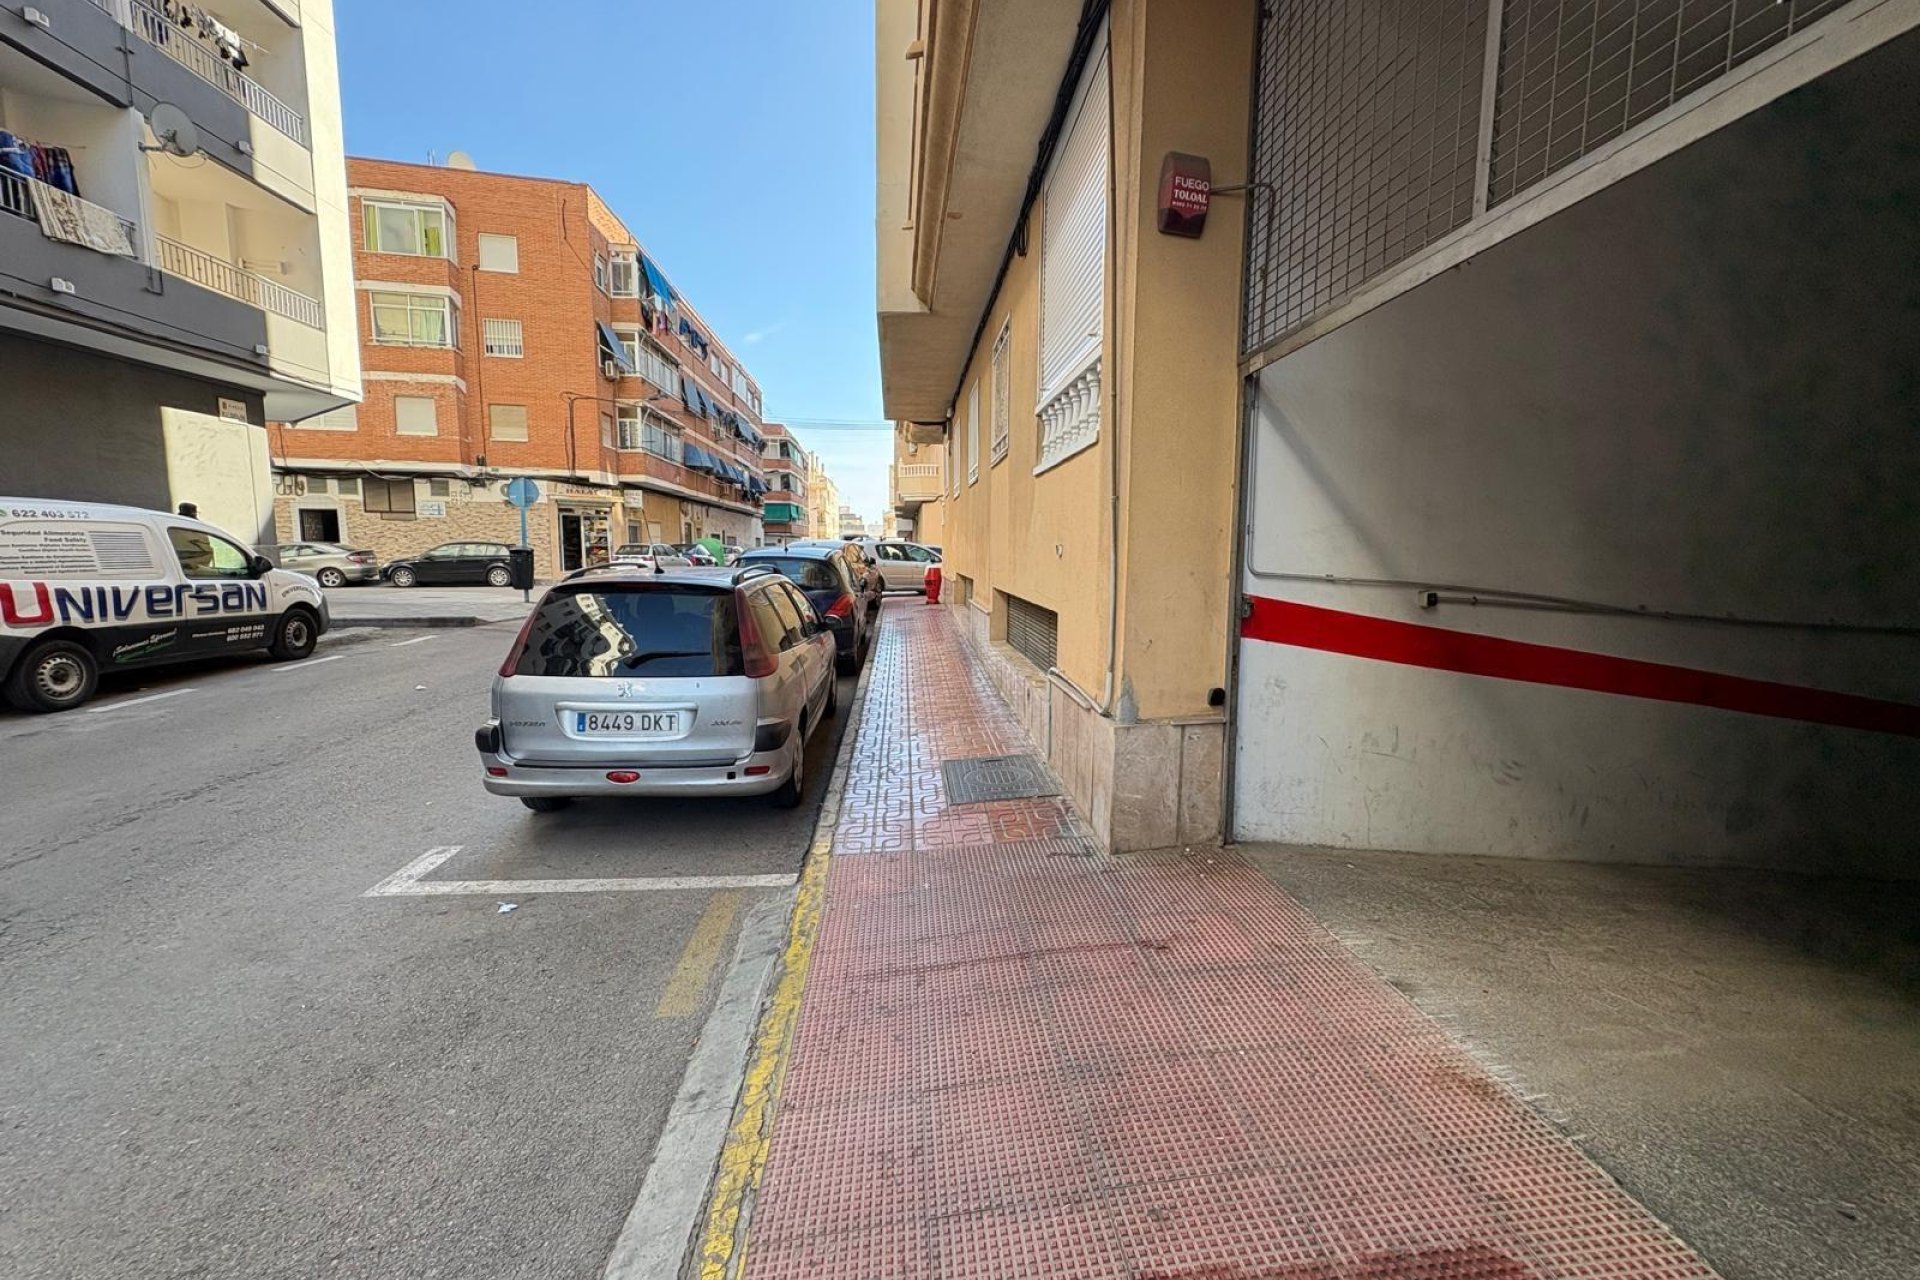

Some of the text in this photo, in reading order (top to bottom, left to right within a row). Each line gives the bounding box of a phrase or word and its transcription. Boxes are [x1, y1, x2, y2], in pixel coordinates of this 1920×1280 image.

[1175, 176, 1209, 191] FUEGO
[11, 509, 38, 518] 622
[589, 714, 676, 731] 8449 DKT
